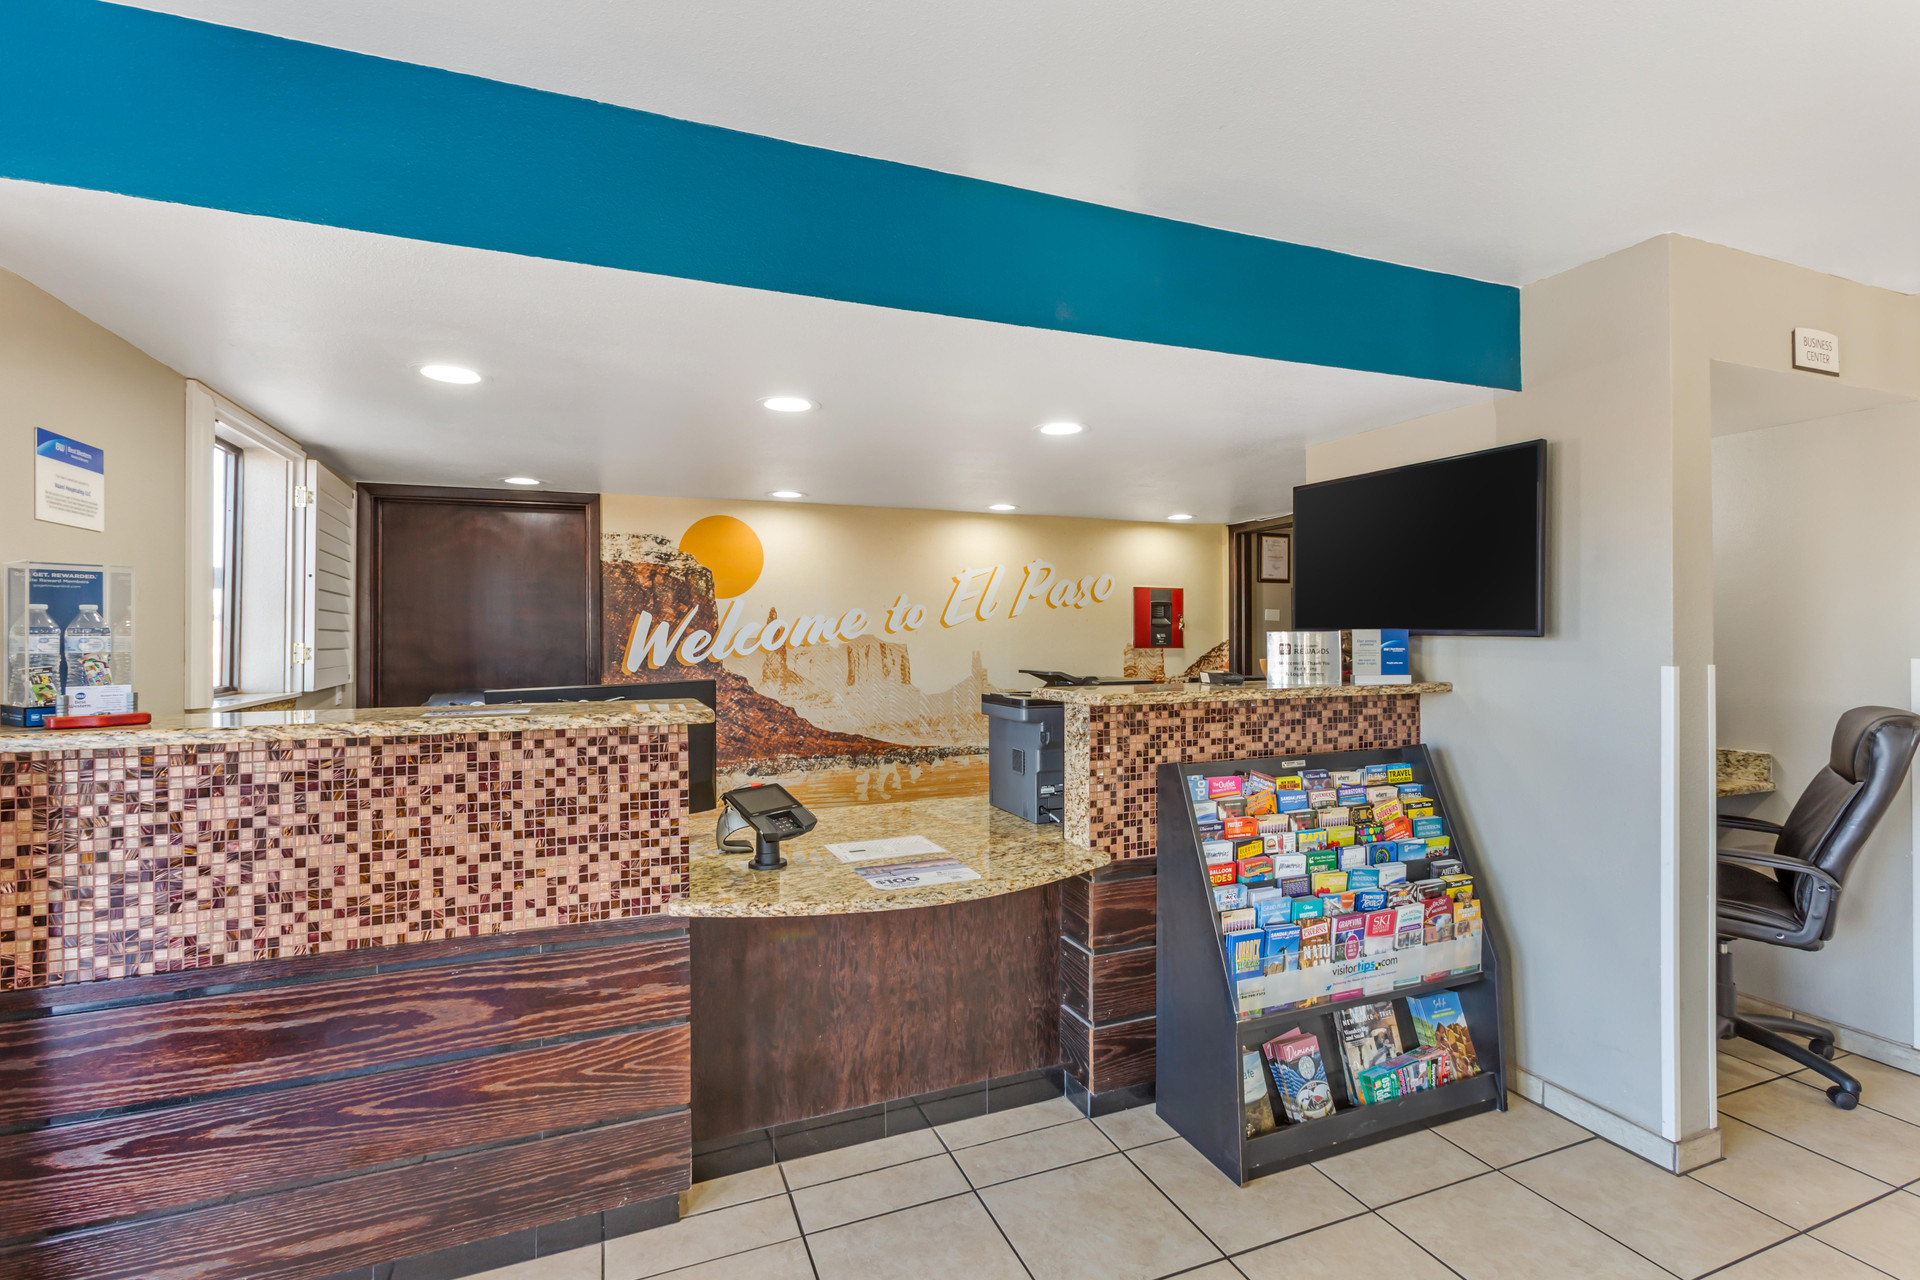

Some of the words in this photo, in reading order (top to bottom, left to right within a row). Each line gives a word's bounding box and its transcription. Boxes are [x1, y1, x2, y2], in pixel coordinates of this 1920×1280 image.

[1803, 336, 1832, 351] BUSINESS
[1806, 350, 1830, 364] CENTER
[51, 572, 97, 580] REWARDED.
[621, 598, 871, 675] Welcome
[884, 593, 927, 634] to
[939, 563, 1005, 629] El
[1007, 558, 1115, 619] Paso
[1389, 770, 1411, 778] TRAVEL
[1218, 780, 1236, 788] Outlet
[1300, 831, 1327, 842] RAFT!
[1239, 842, 1261, 854] ELECTRIC
[1209, 867, 1232, 875] BALLOON
[875, 876, 920, 886] $100
[1210, 873, 1232, 884] RIDES
[1338, 917, 1363, 929] GRAPEVINE
[1373, 914, 1392, 927] SKI
[1379, 1009, 1392, 1018] TRUE
[1285, 1043, 1316, 1062] Deming
